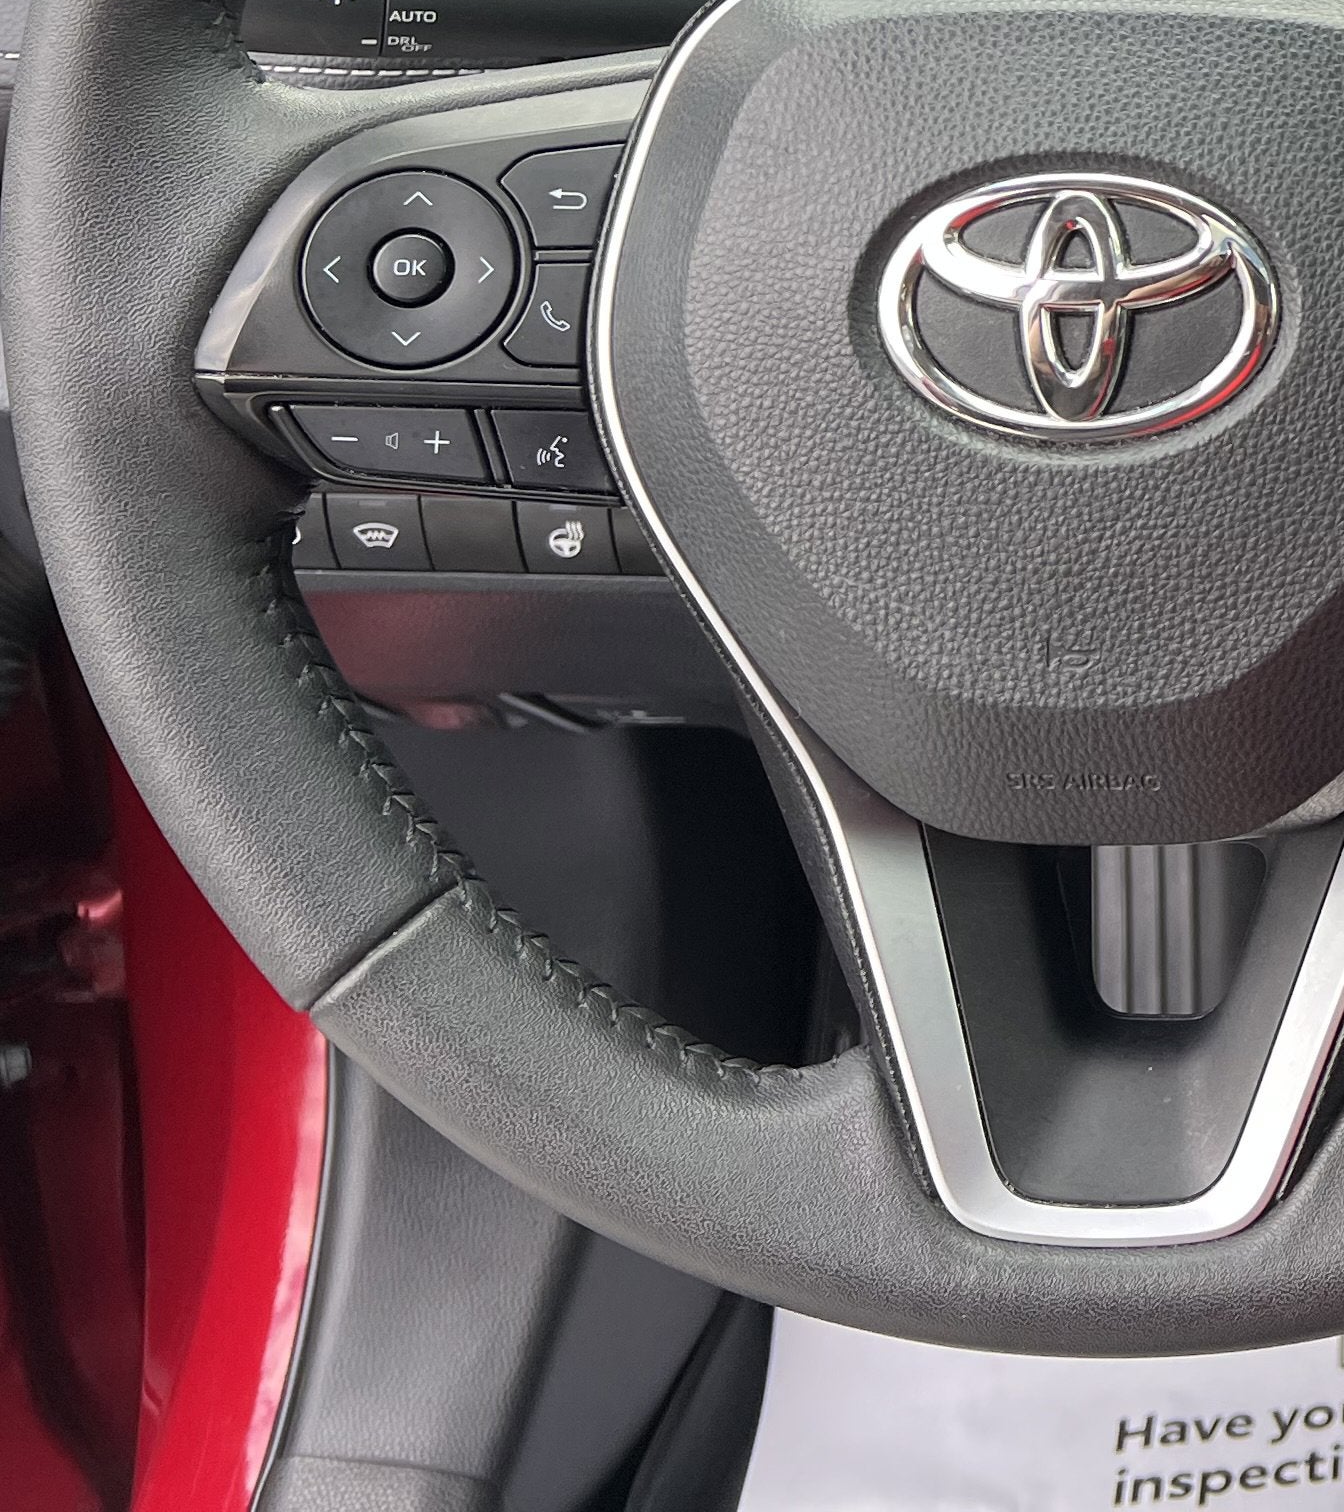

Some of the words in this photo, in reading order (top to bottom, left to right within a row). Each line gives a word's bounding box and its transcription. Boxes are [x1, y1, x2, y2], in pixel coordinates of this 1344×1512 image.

[389, 11, 436, 22] AUTO
[388, 36, 418, 46] DRL
[401, 44, 432, 52] OFF
[394, 260, 426, 275] OK
[1116, 1415, 1253, 1452] Have
